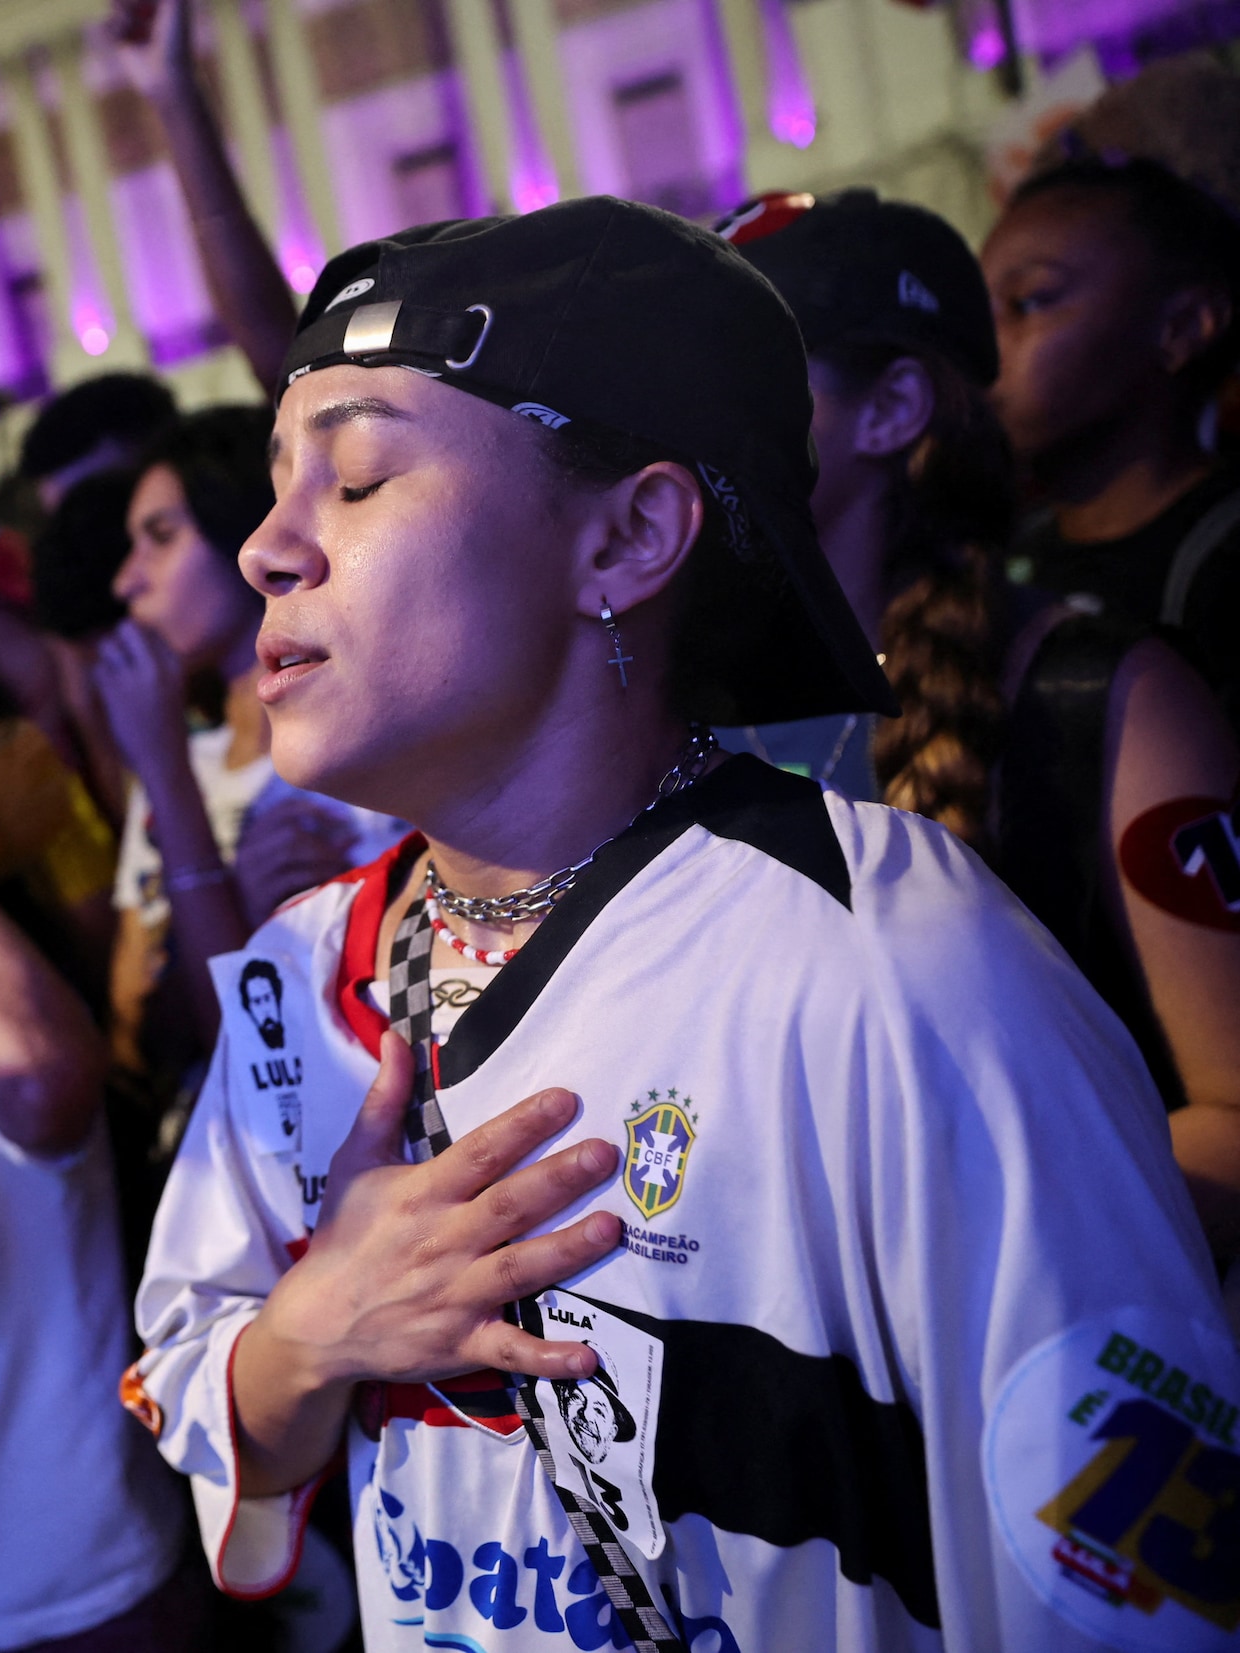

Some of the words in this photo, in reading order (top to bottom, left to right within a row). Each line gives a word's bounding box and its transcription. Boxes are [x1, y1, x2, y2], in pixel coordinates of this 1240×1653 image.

[644, 1149, 674, 1168] CBF
[547, 1307, 594, 1331] LULA
[1095, 1330, 1240, 1447] BRASIL
[1088, 1398, 1240, 1605] 13
